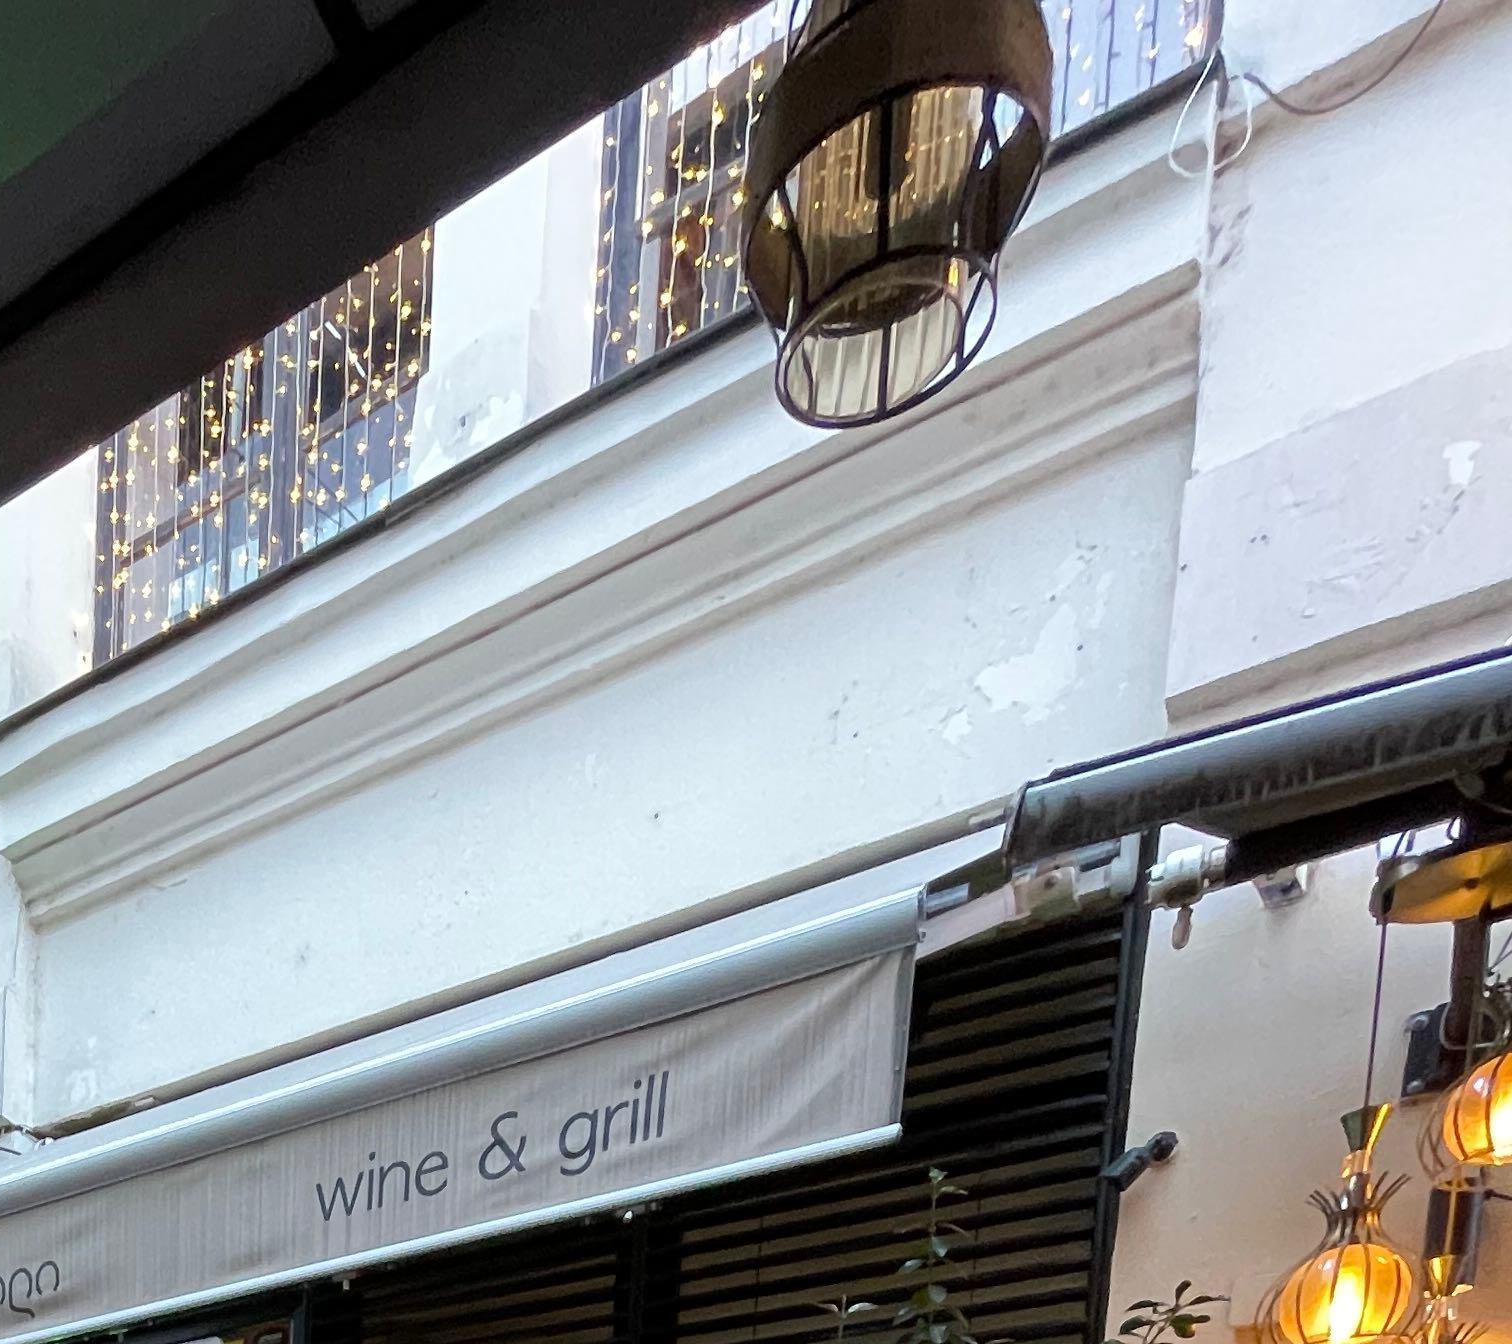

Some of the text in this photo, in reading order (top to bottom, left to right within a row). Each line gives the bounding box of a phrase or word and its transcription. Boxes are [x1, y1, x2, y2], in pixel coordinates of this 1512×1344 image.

[315, 1070, 670, 1222] wine & grill
